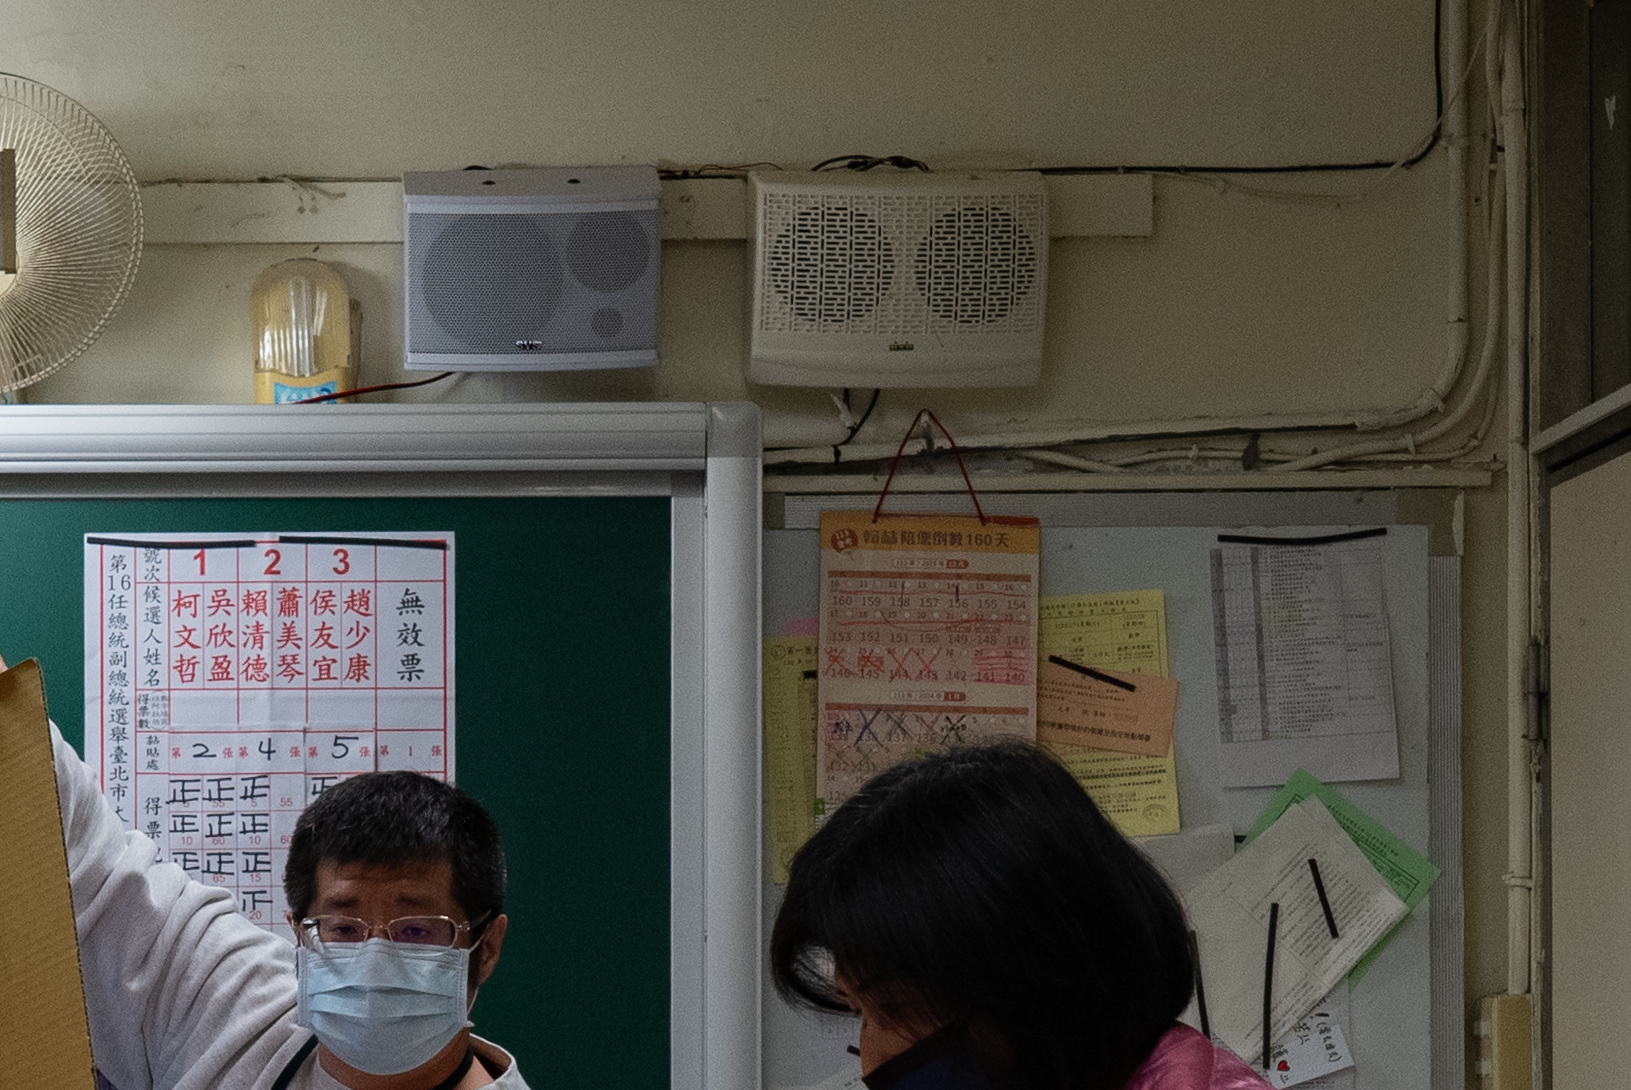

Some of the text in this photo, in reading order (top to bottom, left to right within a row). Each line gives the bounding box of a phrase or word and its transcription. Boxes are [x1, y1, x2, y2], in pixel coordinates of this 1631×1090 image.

[143, 547, 161, 582] 號次
[193, 549, 207, 576] 1
[264, 549, 281, 575] 2
[333, 548, 350, 575] 3
[833, 597, 852, 606] 160
[862, 598, 881, 606] 159
[920, 598, 939, 607] 157
[978, 599, 997, 608] 155
[1007, 600, 1027, 610] 154
[143, 586, 161, 687] 候選人姓名
[171, 590, 201, 683] 柯文哲
[206, 588, 235, 682] 吳欣盈
[240, 589, 269, 682] 賴清德
[276, 586, 305, 683] 蕭美琴
[309, 589, 339, 682] 侯友宜
[343, 588, 373, 682] 趙少康
[396, 588, 425, 682] 無效票
[831, 634, 851, 642] 153
[861, 634, 880, 642] 152
[890, 634, 909, 643] 151
[919, 634, 939, 643] 150
[949, 636, 967, 644] 149
[977, 636, 997, 645] 148
[1006, 637, 1025, 646] 147
[948, 672, 967, 681] 142
[1006, 673, 1025, 682] 140
[137, 694, 151, 729] 得票數
[146, 736, 159, 770] 黏貼處
[171, 743, 234, 758] 第 2 張
[239, 738, 301, 760] 第 4 張
[309, 735, 371, 758] 第 5 張
[380, 745, 443, 756] 第 1 張
[166, 779, 201, 804] 正
[203, 778, 235, 802] 正
[239, 776, 270, 800] 正
[281, 798, 293, 807] 55
[169, 814, 199, 832] 正
[205, 812, 235, 838] 正
[239, 814, 269, 834] 正
[181, 836, 193, 846] 10
[250, 836, 261, 845] 10
[201, 852, 235, 876] 正
[242, 852, 271, 873] 正
[250, 874, 261, 882] 15
[249, 910, 262, 919] 20
